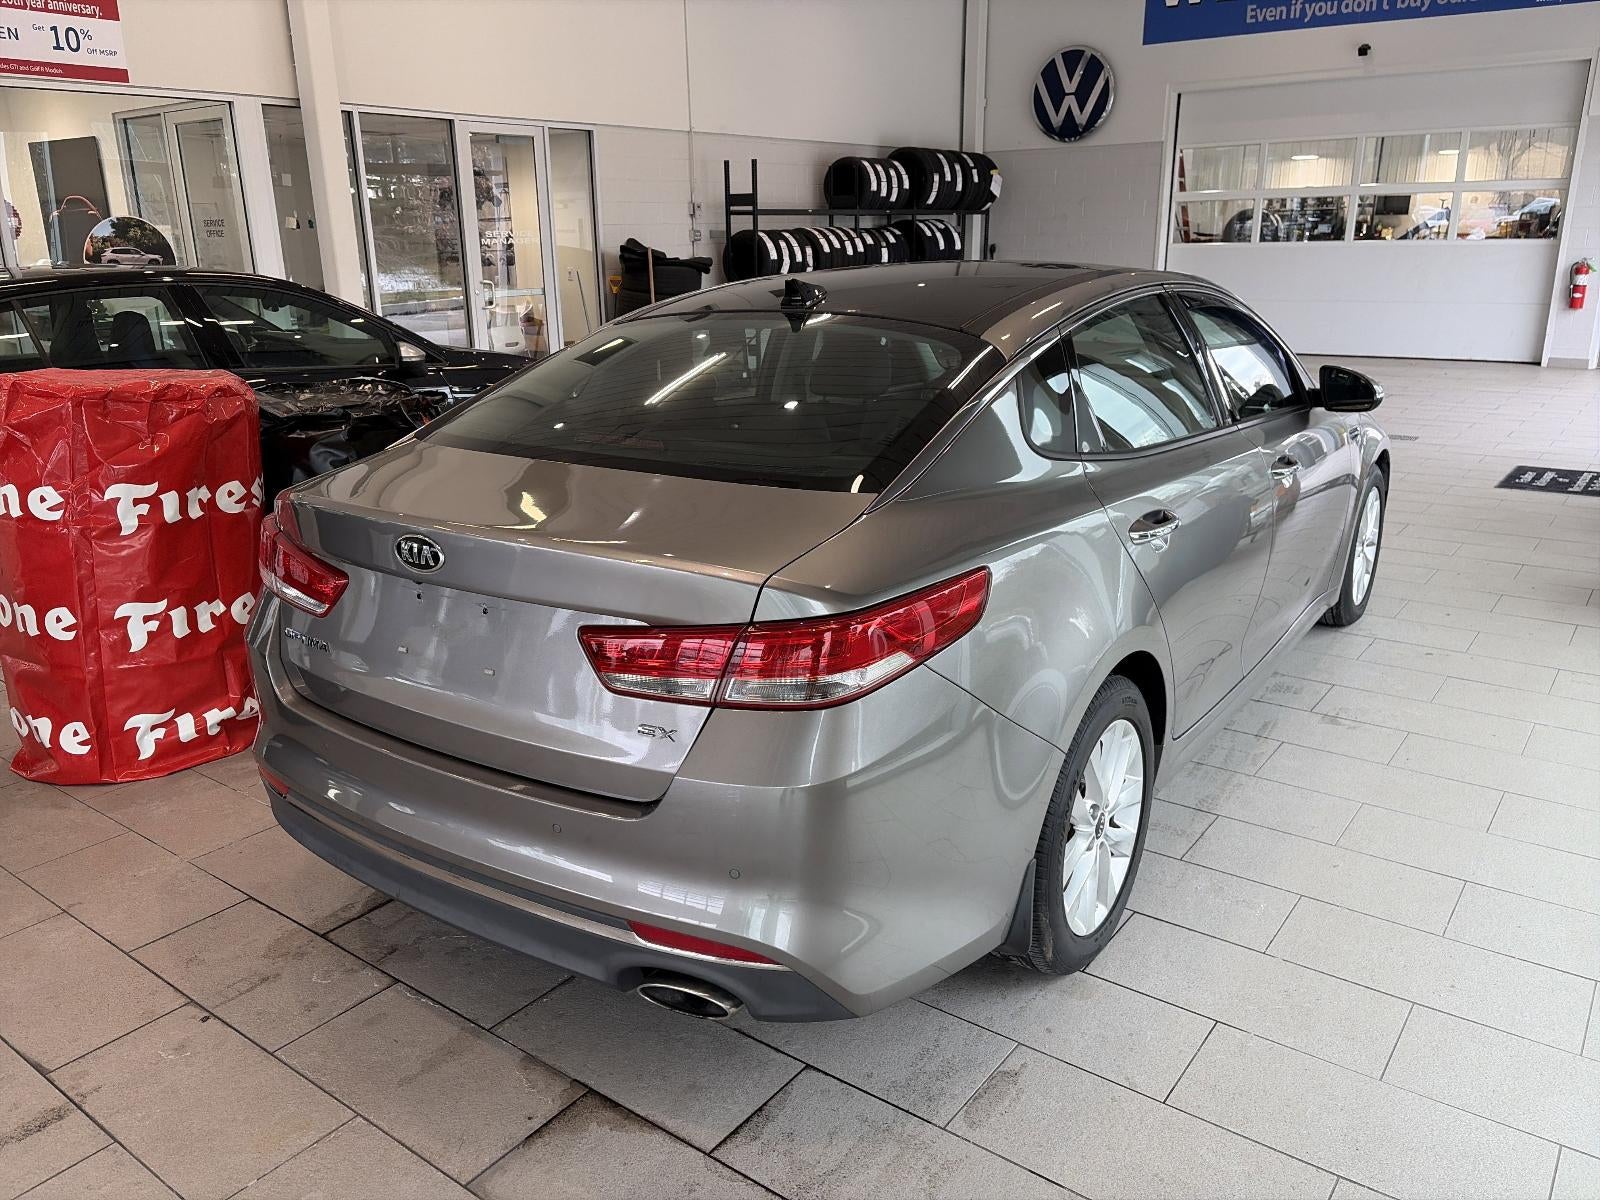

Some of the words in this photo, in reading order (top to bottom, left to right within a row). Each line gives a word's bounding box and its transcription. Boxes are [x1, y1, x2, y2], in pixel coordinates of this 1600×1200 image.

[26, 0, 45, 10] year
[48, 0, 102, 19] anniversary.
[1246, 5, 1287, 24] Even
[1290, 0, 1305, 18] if
[1304, 3, 1338, 22] you
[1341, 0, 1389, 13] dont
[32, 23, 45, 32] Get
[86, 47, 98, 56] Off
[99, 48, 118, 57] MSRP
[203, 219, 225, 228] SERVICE
[206, 229, 225, 238] OFFICE
[400, 540, 435, 566] KIA
[10, 706, 92, 756] one
